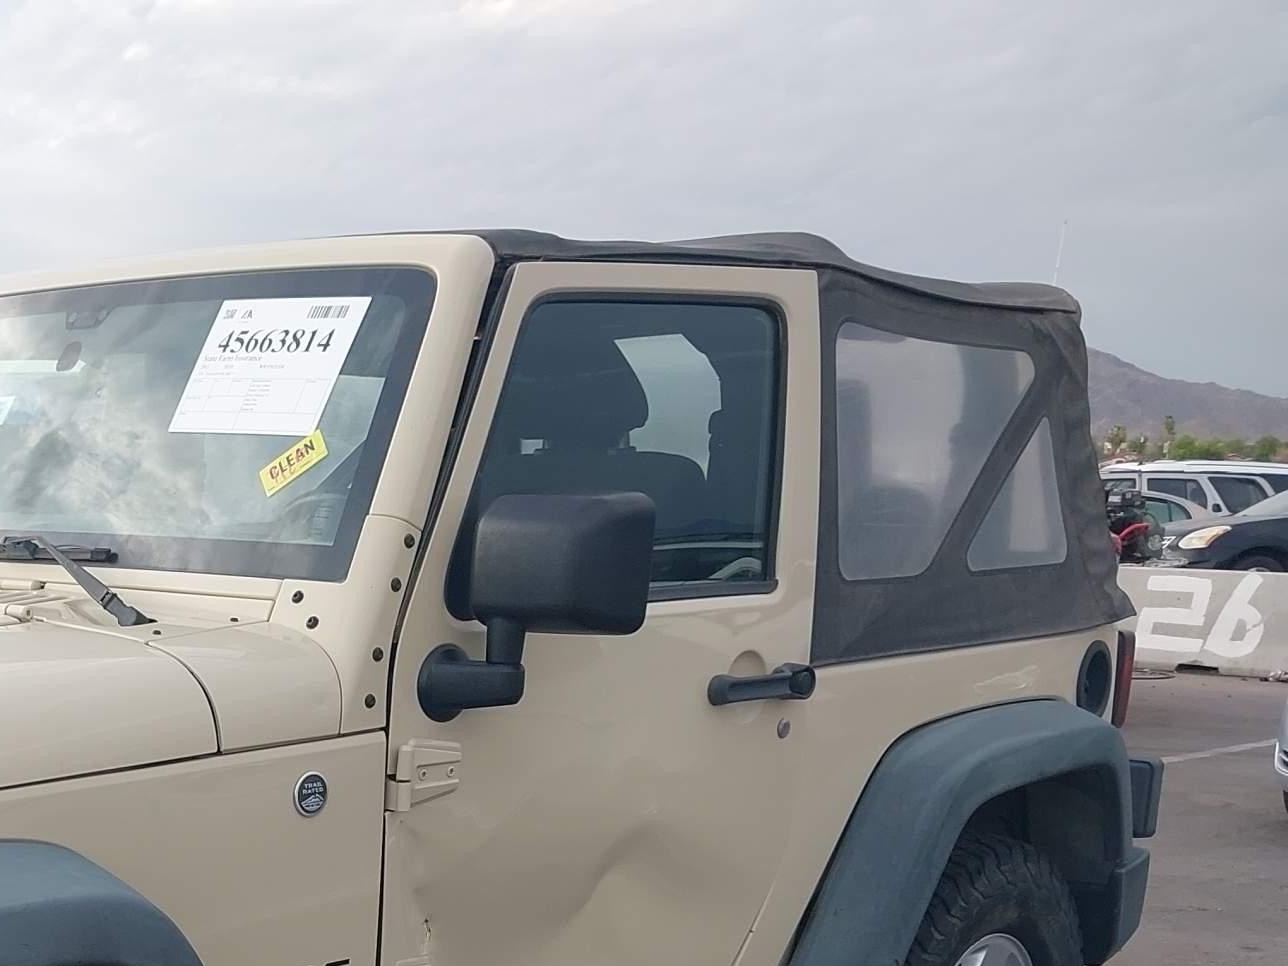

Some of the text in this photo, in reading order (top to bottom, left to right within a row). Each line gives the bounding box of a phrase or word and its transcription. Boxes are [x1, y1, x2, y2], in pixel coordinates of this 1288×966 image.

[218, 328, 336, 354] 45663814
[269, 439, 315, 480] CLEAN
[1136, 572, 1265, 658] 26
[304, 781, 322, 789] TRAIL
